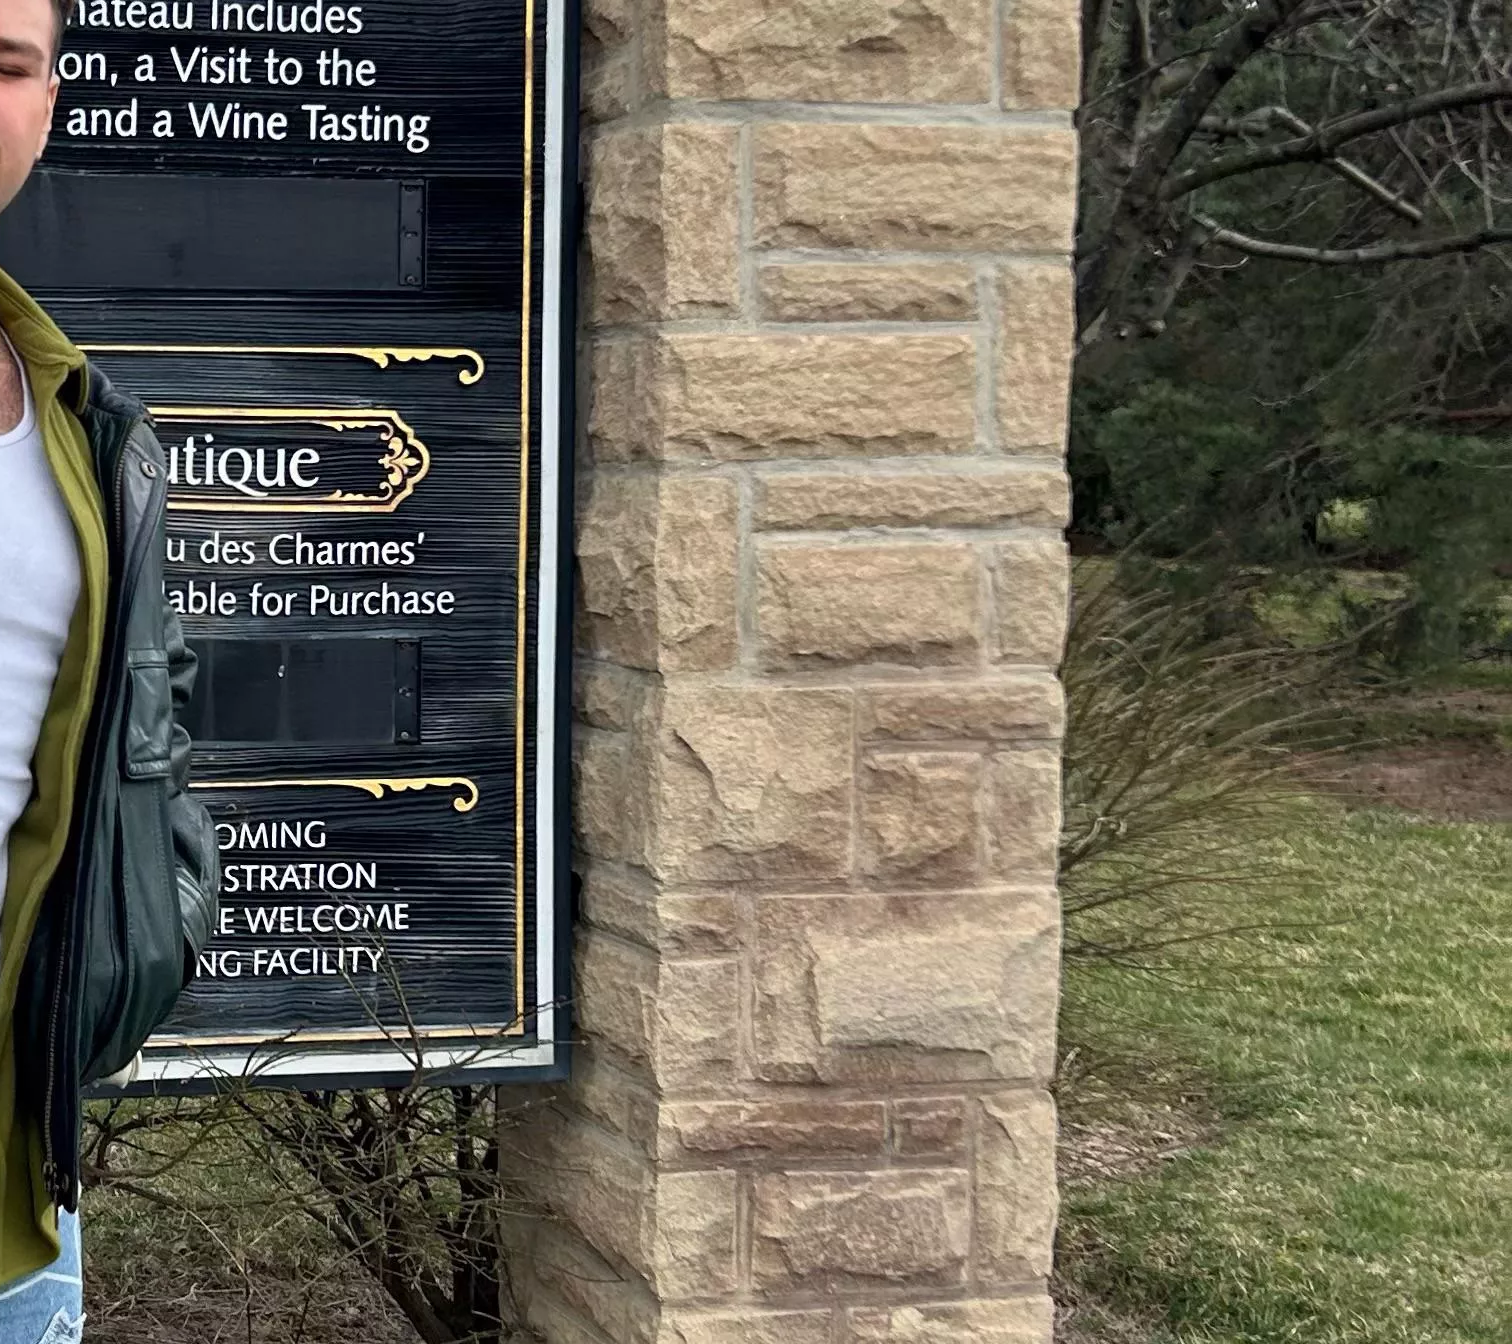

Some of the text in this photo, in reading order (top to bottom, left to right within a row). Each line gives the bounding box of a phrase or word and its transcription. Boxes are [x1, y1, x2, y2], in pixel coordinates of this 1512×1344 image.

[134, 54, 157, 82] a
[170, 46, 252, 84] Visit
[263, 48, 303, 86] to
[316, 49, 376, 87] the
[66, 98, 138, 137] and
[152, 110, 175, 138] a
[188, 102, 288, 141] Wine
[301, 104, 431, 154] Tasting
[199, 529, 256, 565] des
[248, 582, 298, 616] for
[310, 582, 455, 616] Purchase
[218, 862, 377, 893] STRATION
[244, 903, 409, 934] WELCOME
[253, 946, 382, 976] FACILITY
